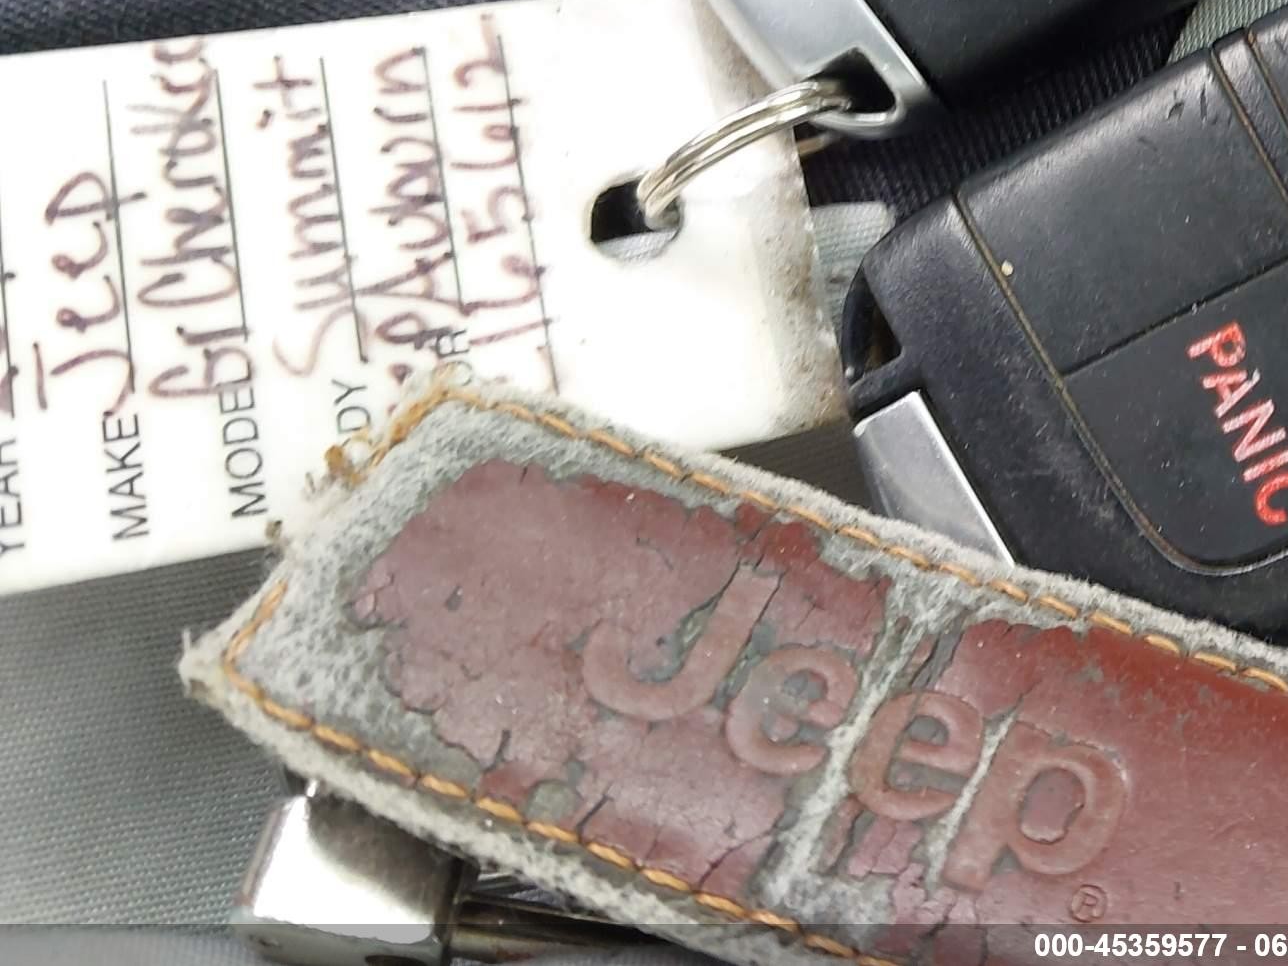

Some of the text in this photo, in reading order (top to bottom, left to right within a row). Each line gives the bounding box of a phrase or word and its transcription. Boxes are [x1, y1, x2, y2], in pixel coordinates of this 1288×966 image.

[33, 171, 146, 418] Jeep
[252, 55, 371, 378] Summit
[357, 47, 469, 316] Auburn
[101, 414, 150, 540] MAKE
[217, 362, 269, 518] MODEL
[582, 561, 1132, 893] Jeep
